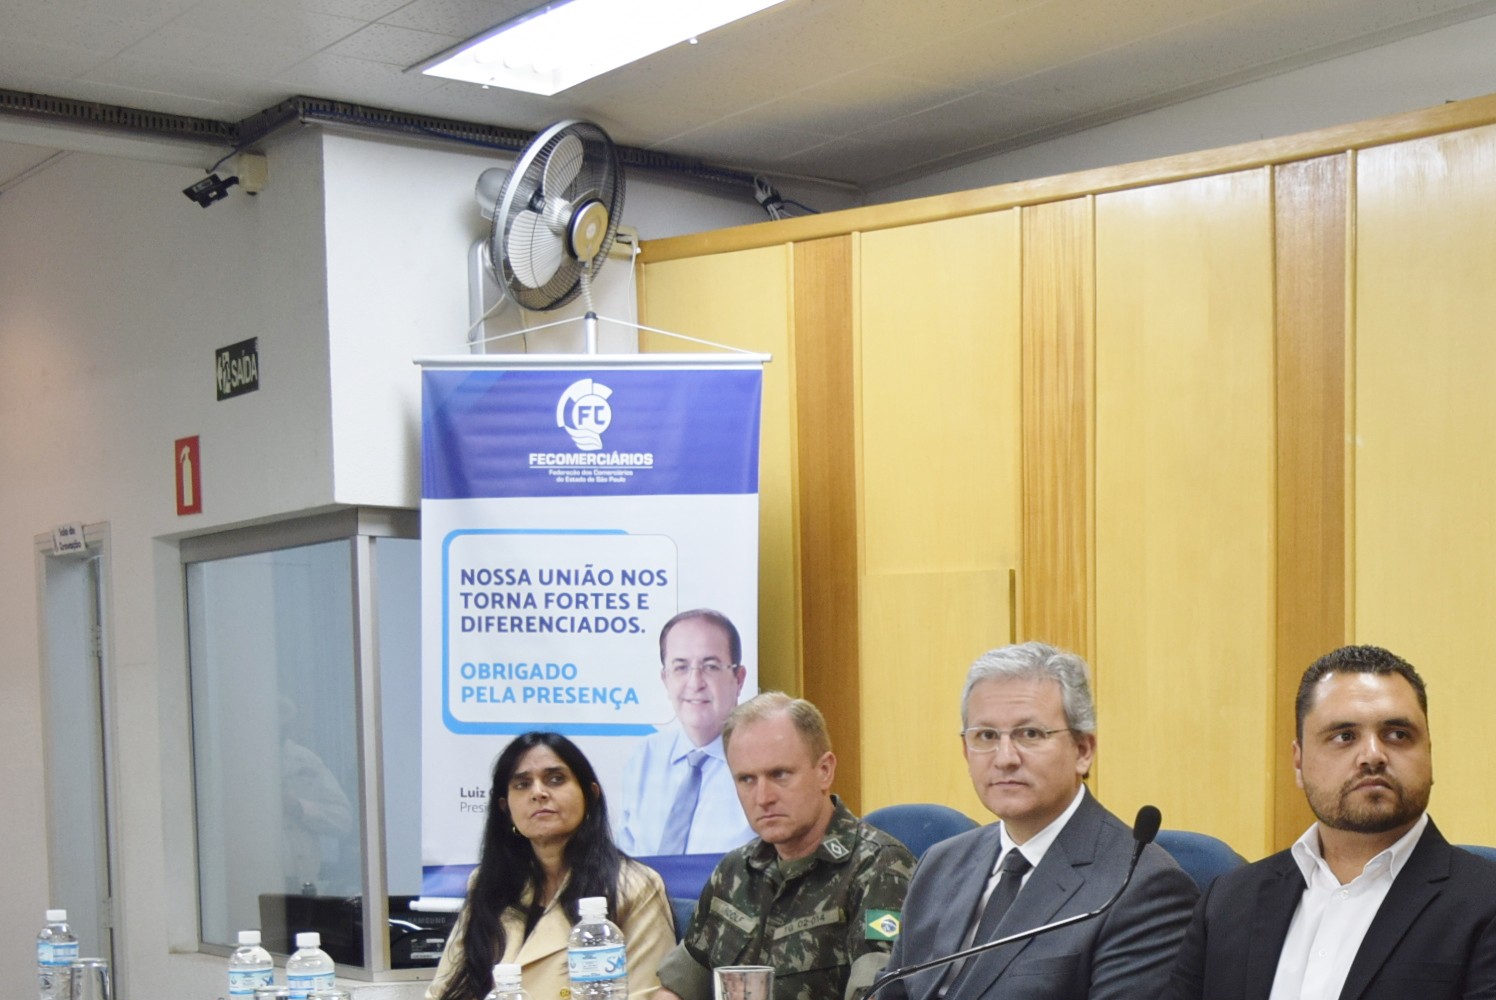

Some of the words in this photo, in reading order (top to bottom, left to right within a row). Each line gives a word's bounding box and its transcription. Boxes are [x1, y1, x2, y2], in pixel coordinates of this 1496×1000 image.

[231, 350, 257, 388] SAÍDA
[577, 405, 606, 426] FC
[529, 450, 653, 465] FECOMERCIÁRIOS
[460, 568, 531, 586] NOSSA
[538, 563, 614, 587] UNIÃO
[621, 569, 668, 587] NOS
[460, 592, 537, 610] TORNA
[544, 592, 630, 610] FORTES
[637, 593, 650, 610] E
[460, 616, 646, 633] DIFERENCIADOS.
[460, 662, 578, 680] OBRIGADO
[460, 686, 516, 704] PELA
[523, 686, 640, 710] PRESENÇA
[460, 786, 486, 798] Luiz
